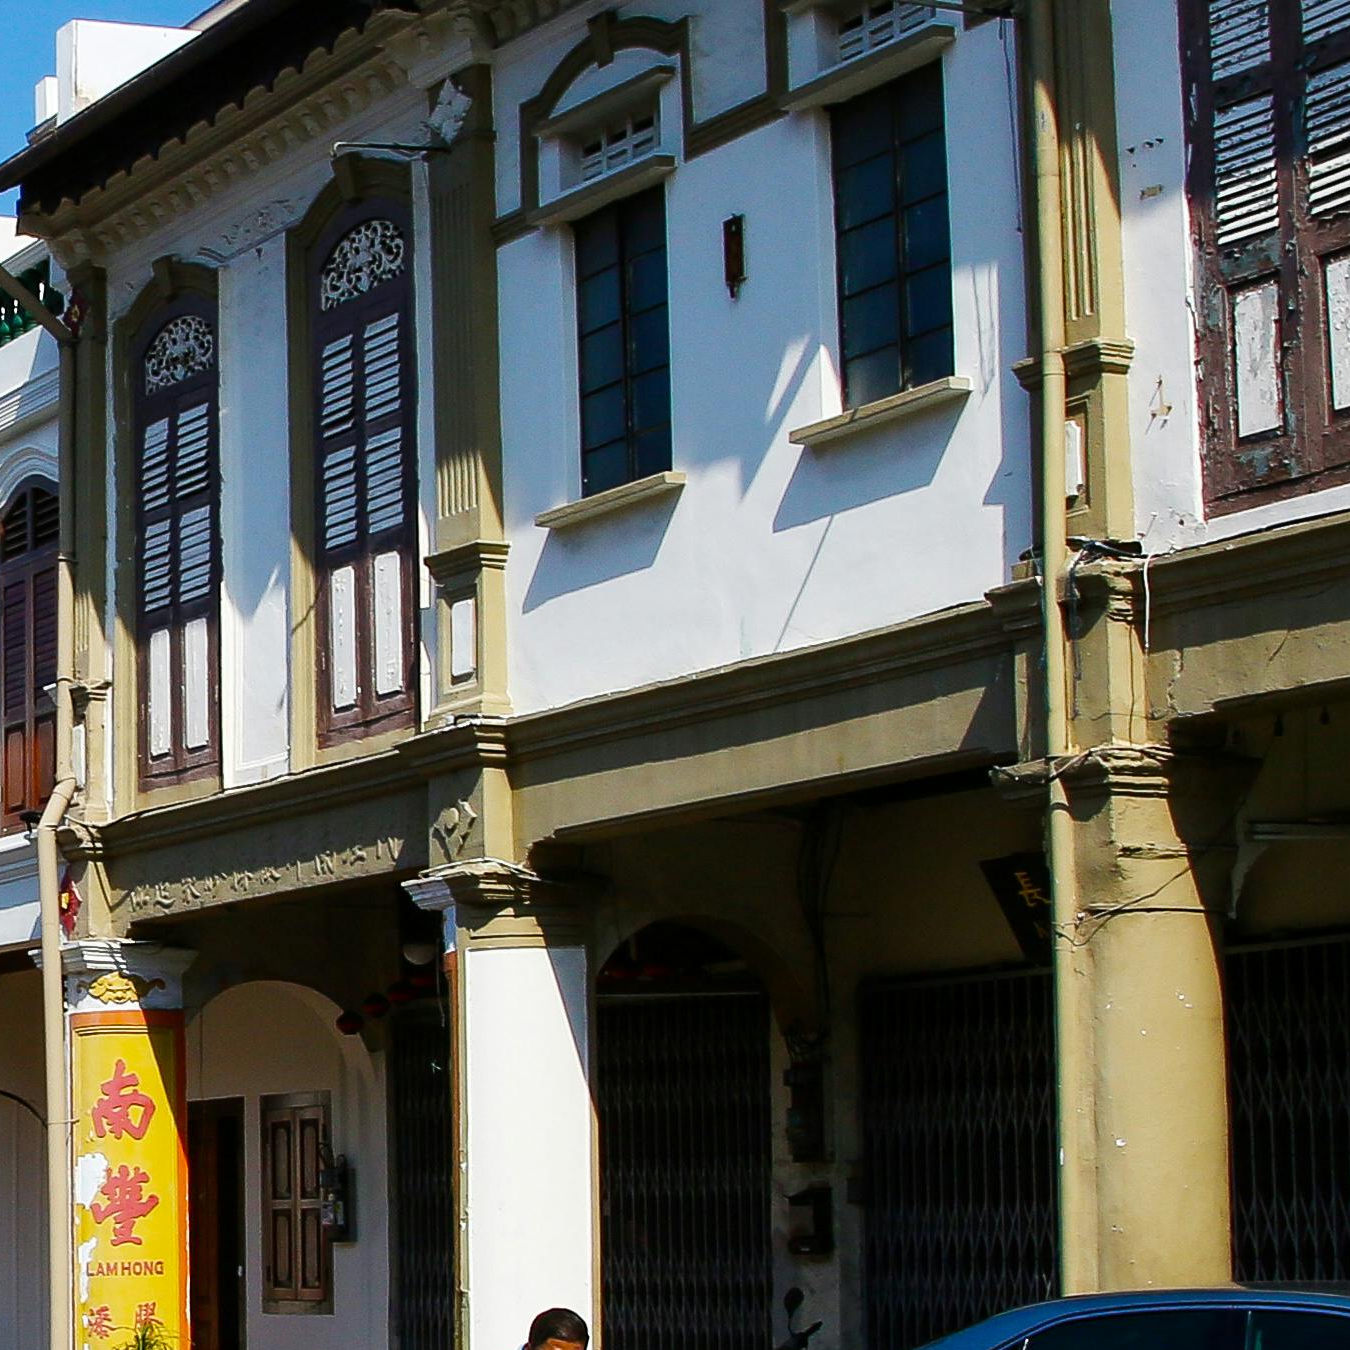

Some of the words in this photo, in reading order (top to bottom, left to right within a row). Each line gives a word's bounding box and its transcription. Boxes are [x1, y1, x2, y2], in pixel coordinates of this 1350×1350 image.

[90, 1058, 160, 1246] 南豐
[86, 1262, 118, 1277] LAM
[121, 1261, 164, 1276] HONG
